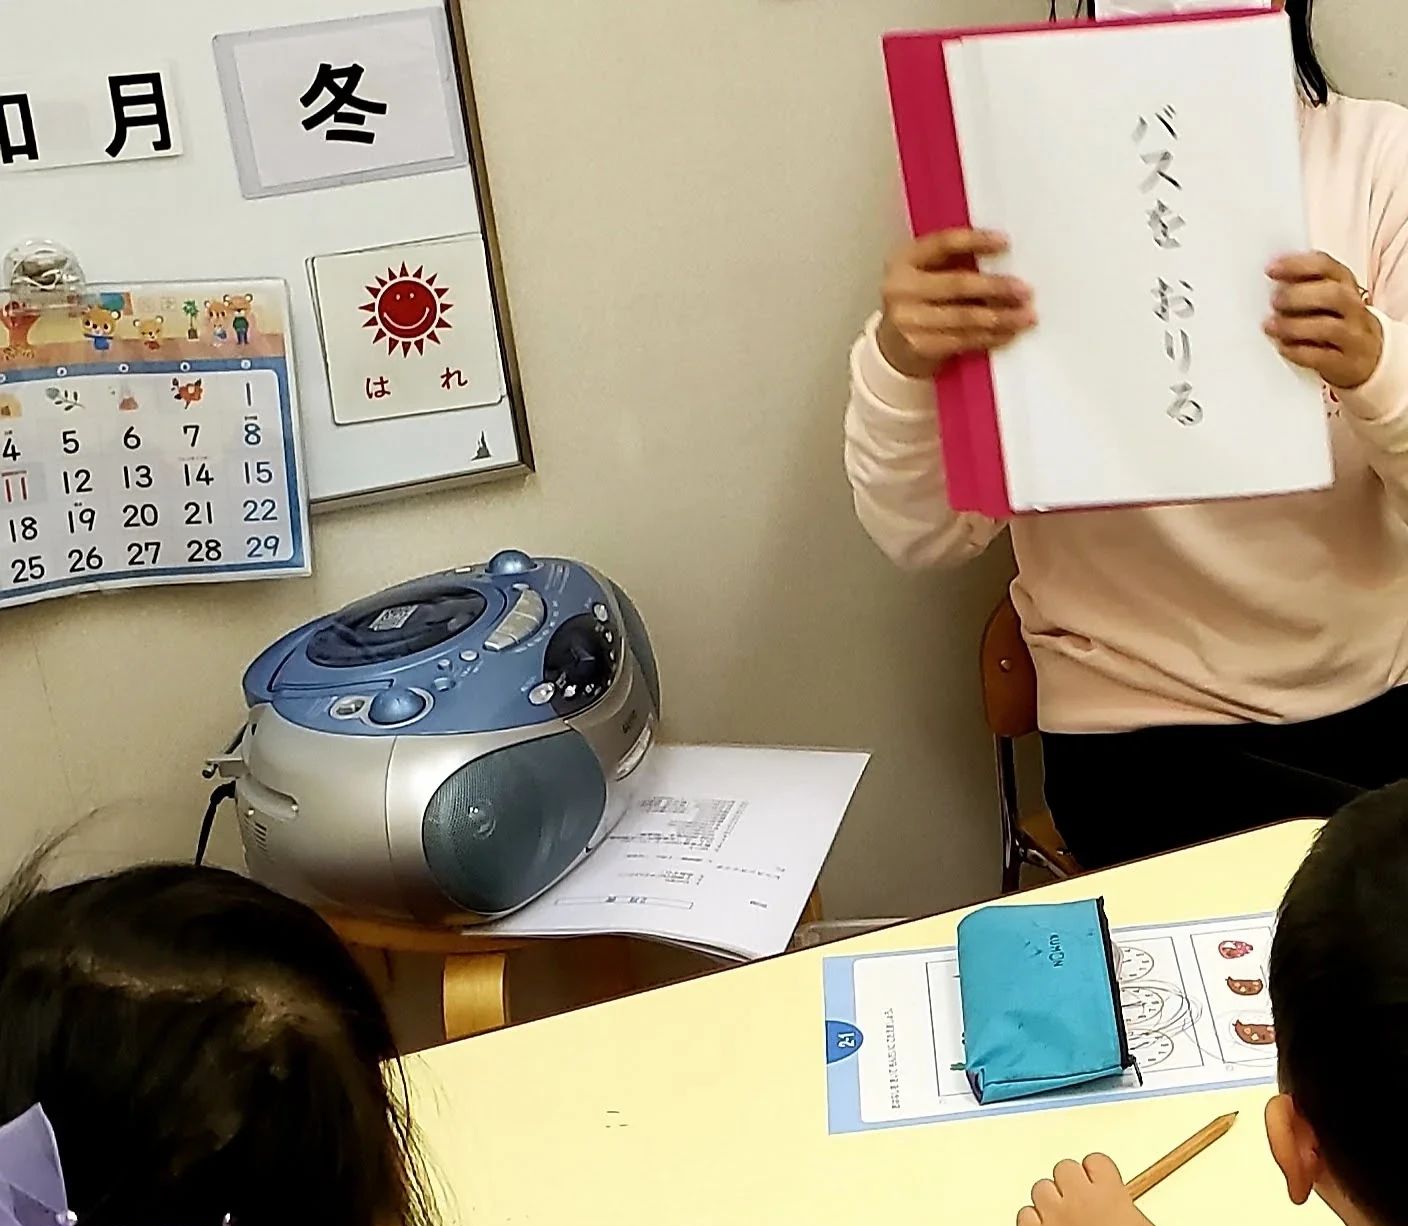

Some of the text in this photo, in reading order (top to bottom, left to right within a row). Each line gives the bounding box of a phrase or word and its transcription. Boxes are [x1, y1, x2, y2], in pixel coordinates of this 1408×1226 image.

[299, 62, 388, 145] 冬
[2, 422, 262, 462] 4 5 6 7 8
[5, 460, 273, 503] 11 12 13 14 15
[9, 499, 278, 544] 18 19 20 21 22
[11, 535, 280, 584] 25 26 27 28 29
